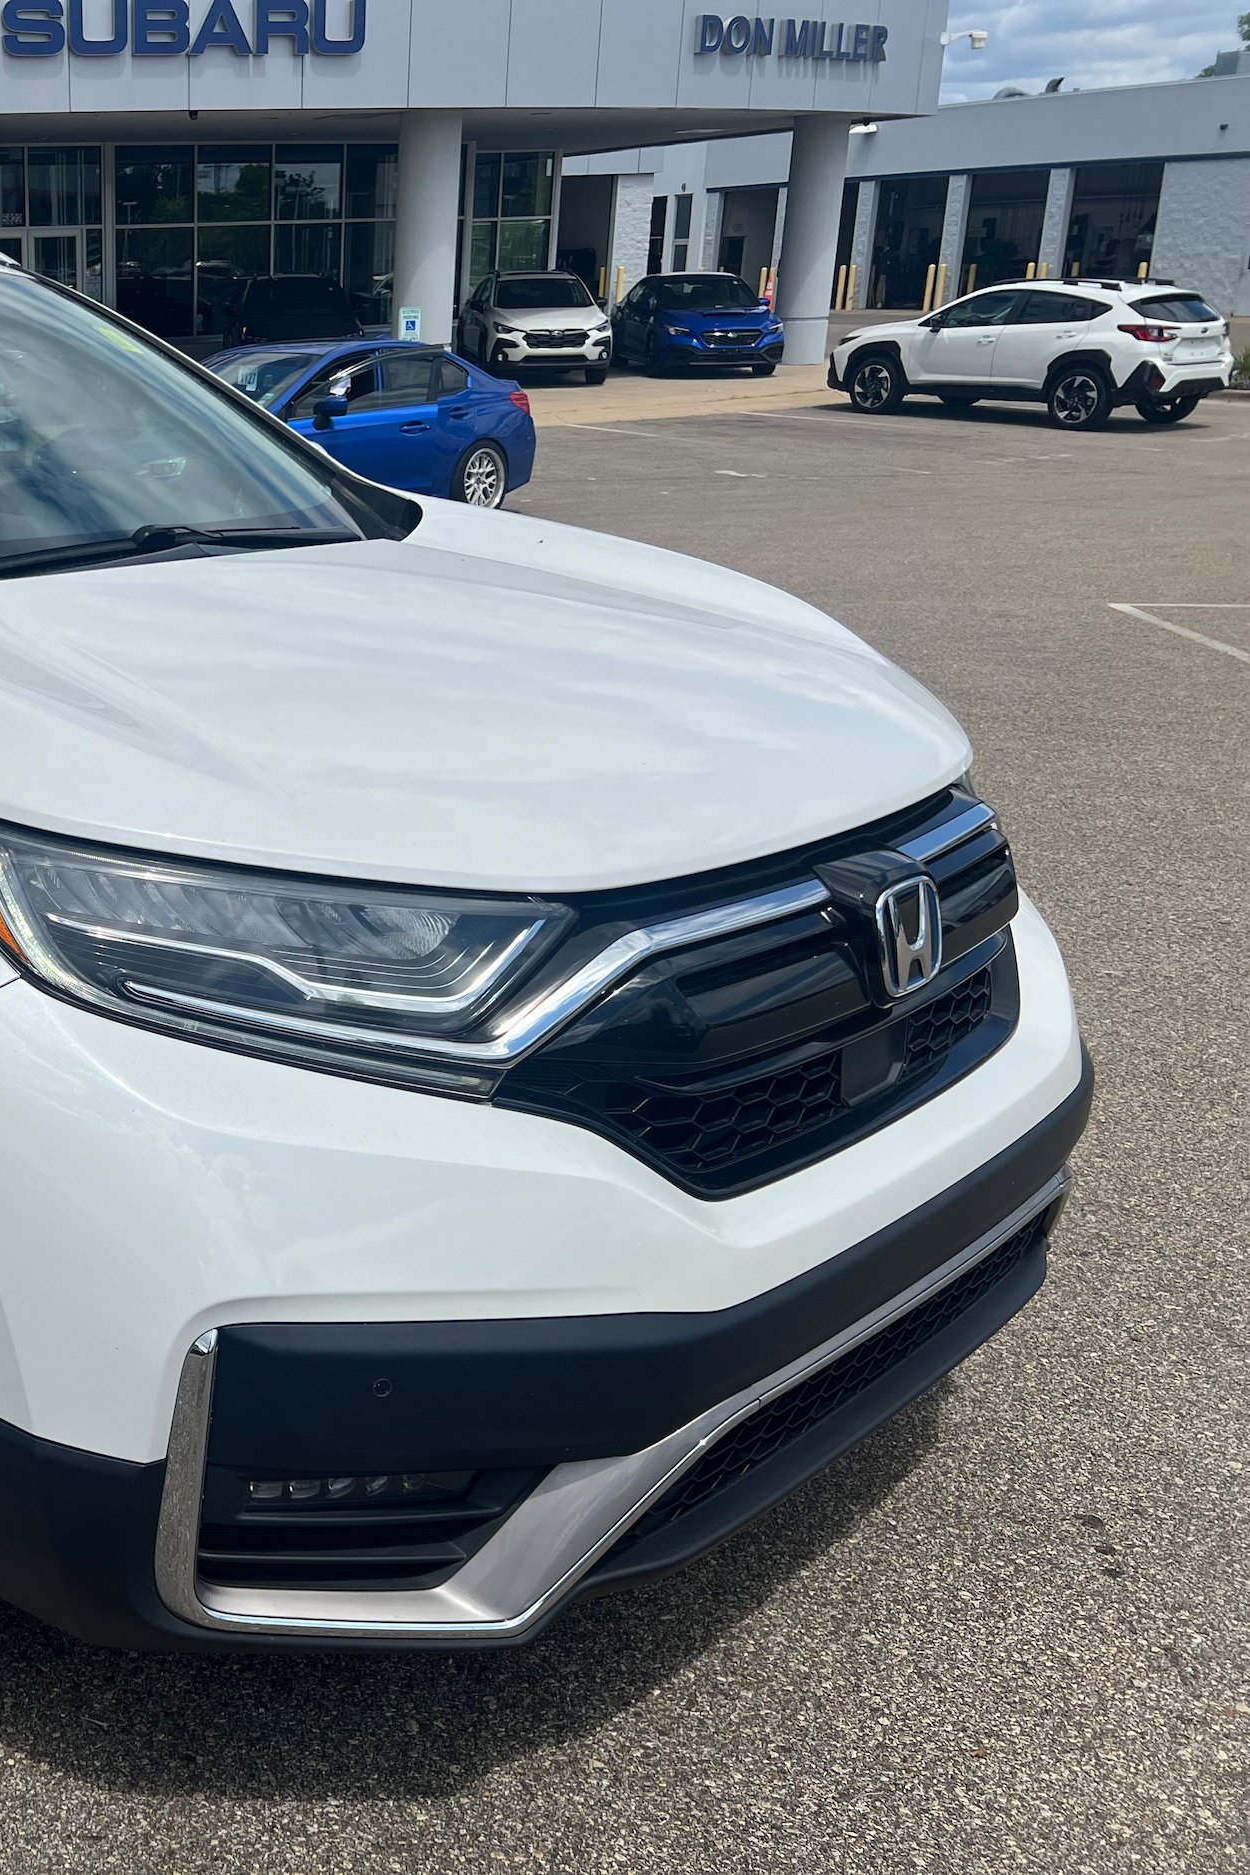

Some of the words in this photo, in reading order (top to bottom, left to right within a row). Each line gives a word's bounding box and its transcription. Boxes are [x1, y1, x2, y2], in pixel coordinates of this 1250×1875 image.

[2, 0, 366, 57] SUBARU
[695, 14, 775, 55] DON
[781, 18, 889, 62] MILLER
